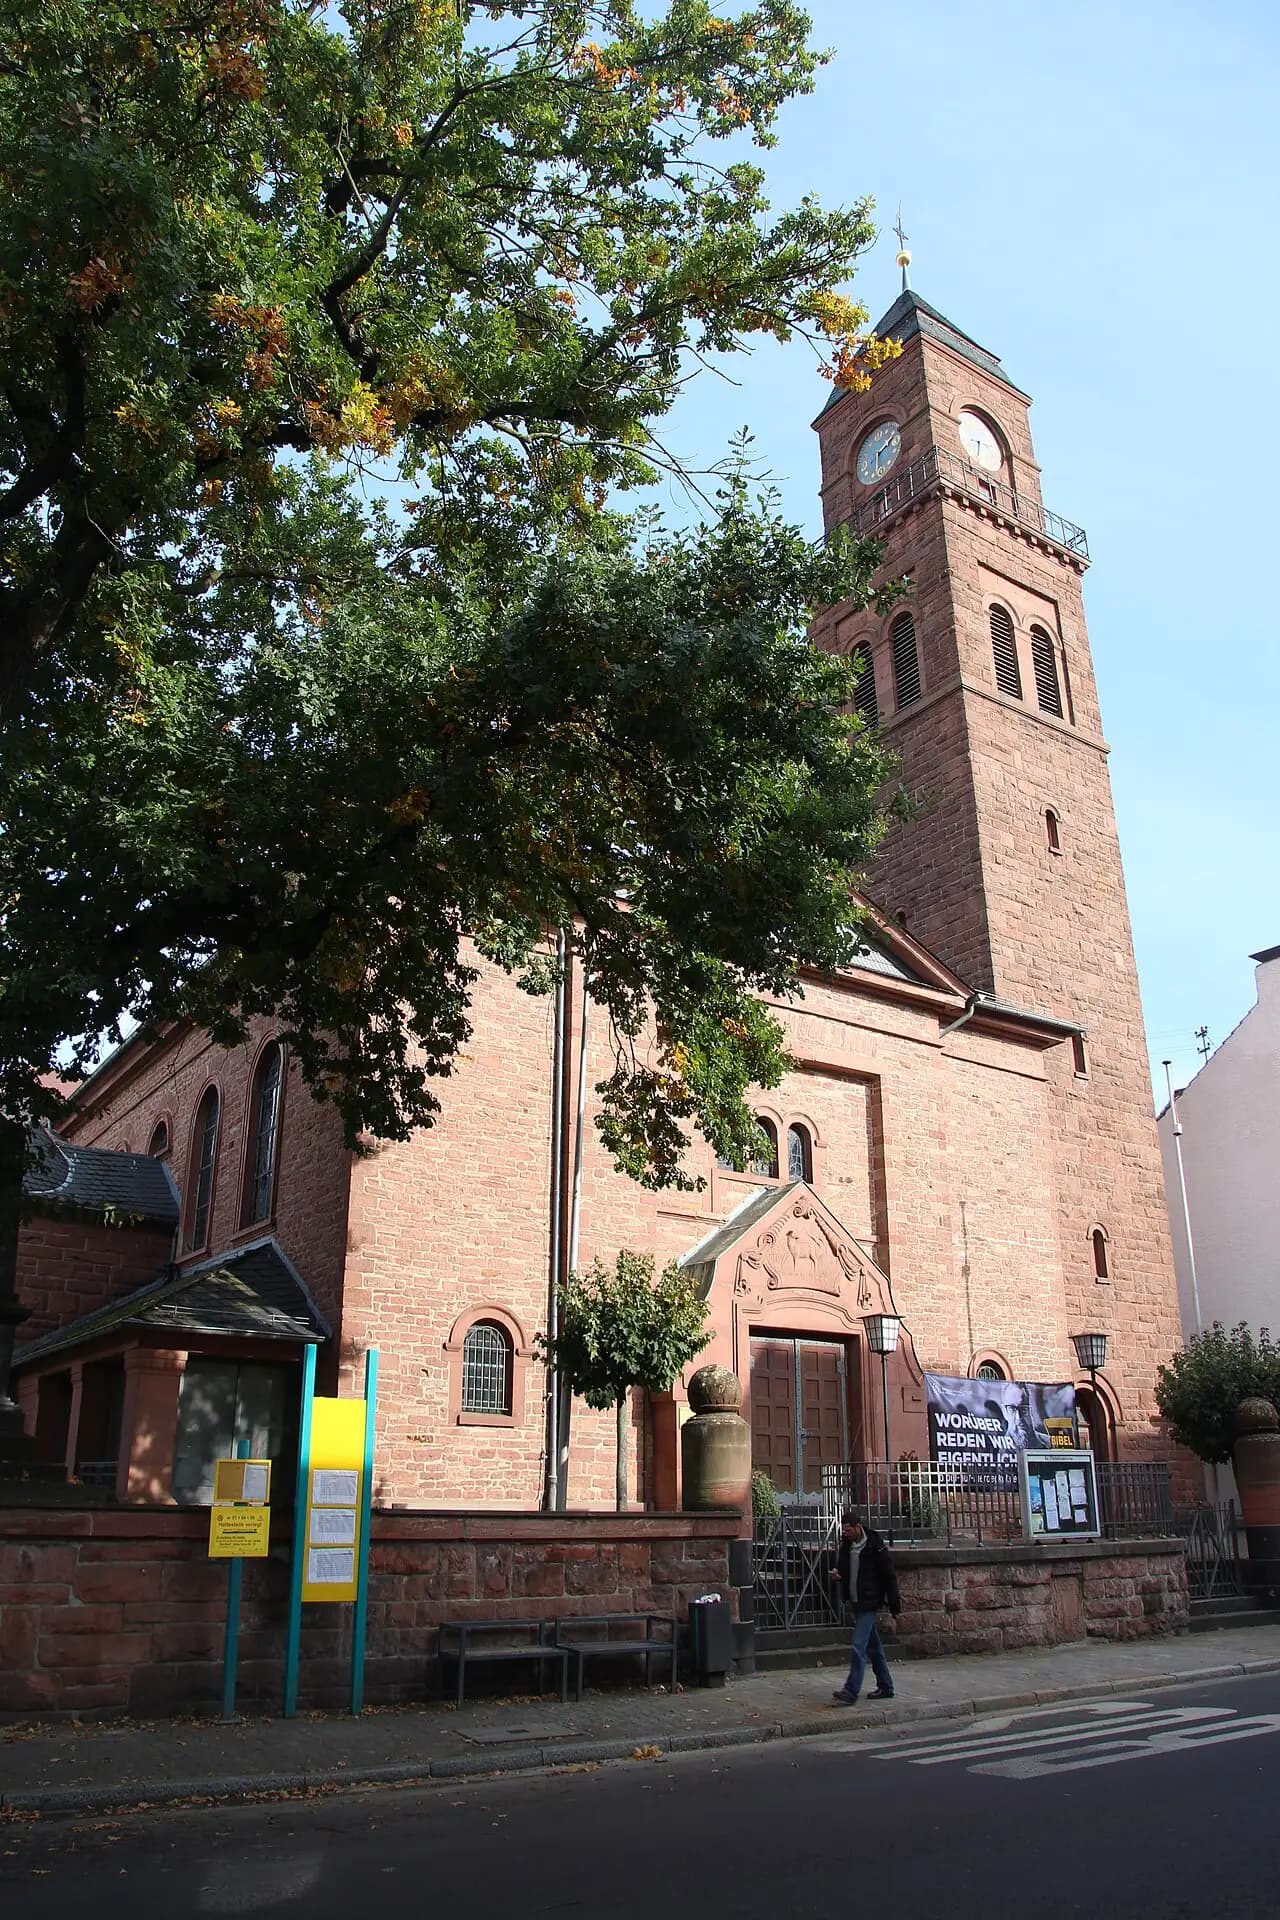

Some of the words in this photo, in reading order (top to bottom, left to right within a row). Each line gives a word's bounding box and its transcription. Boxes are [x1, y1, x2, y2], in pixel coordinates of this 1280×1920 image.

[935, 1412, 1003, 1432] WORÜBER
[936, 1432, 986, 1448] REDEN
[988, 1435, 1016, 1449] WIR
[1051, 1435, 1073, 1446] BIBEL
[937, 1451, 1018, 1467] EIGENTLICH
